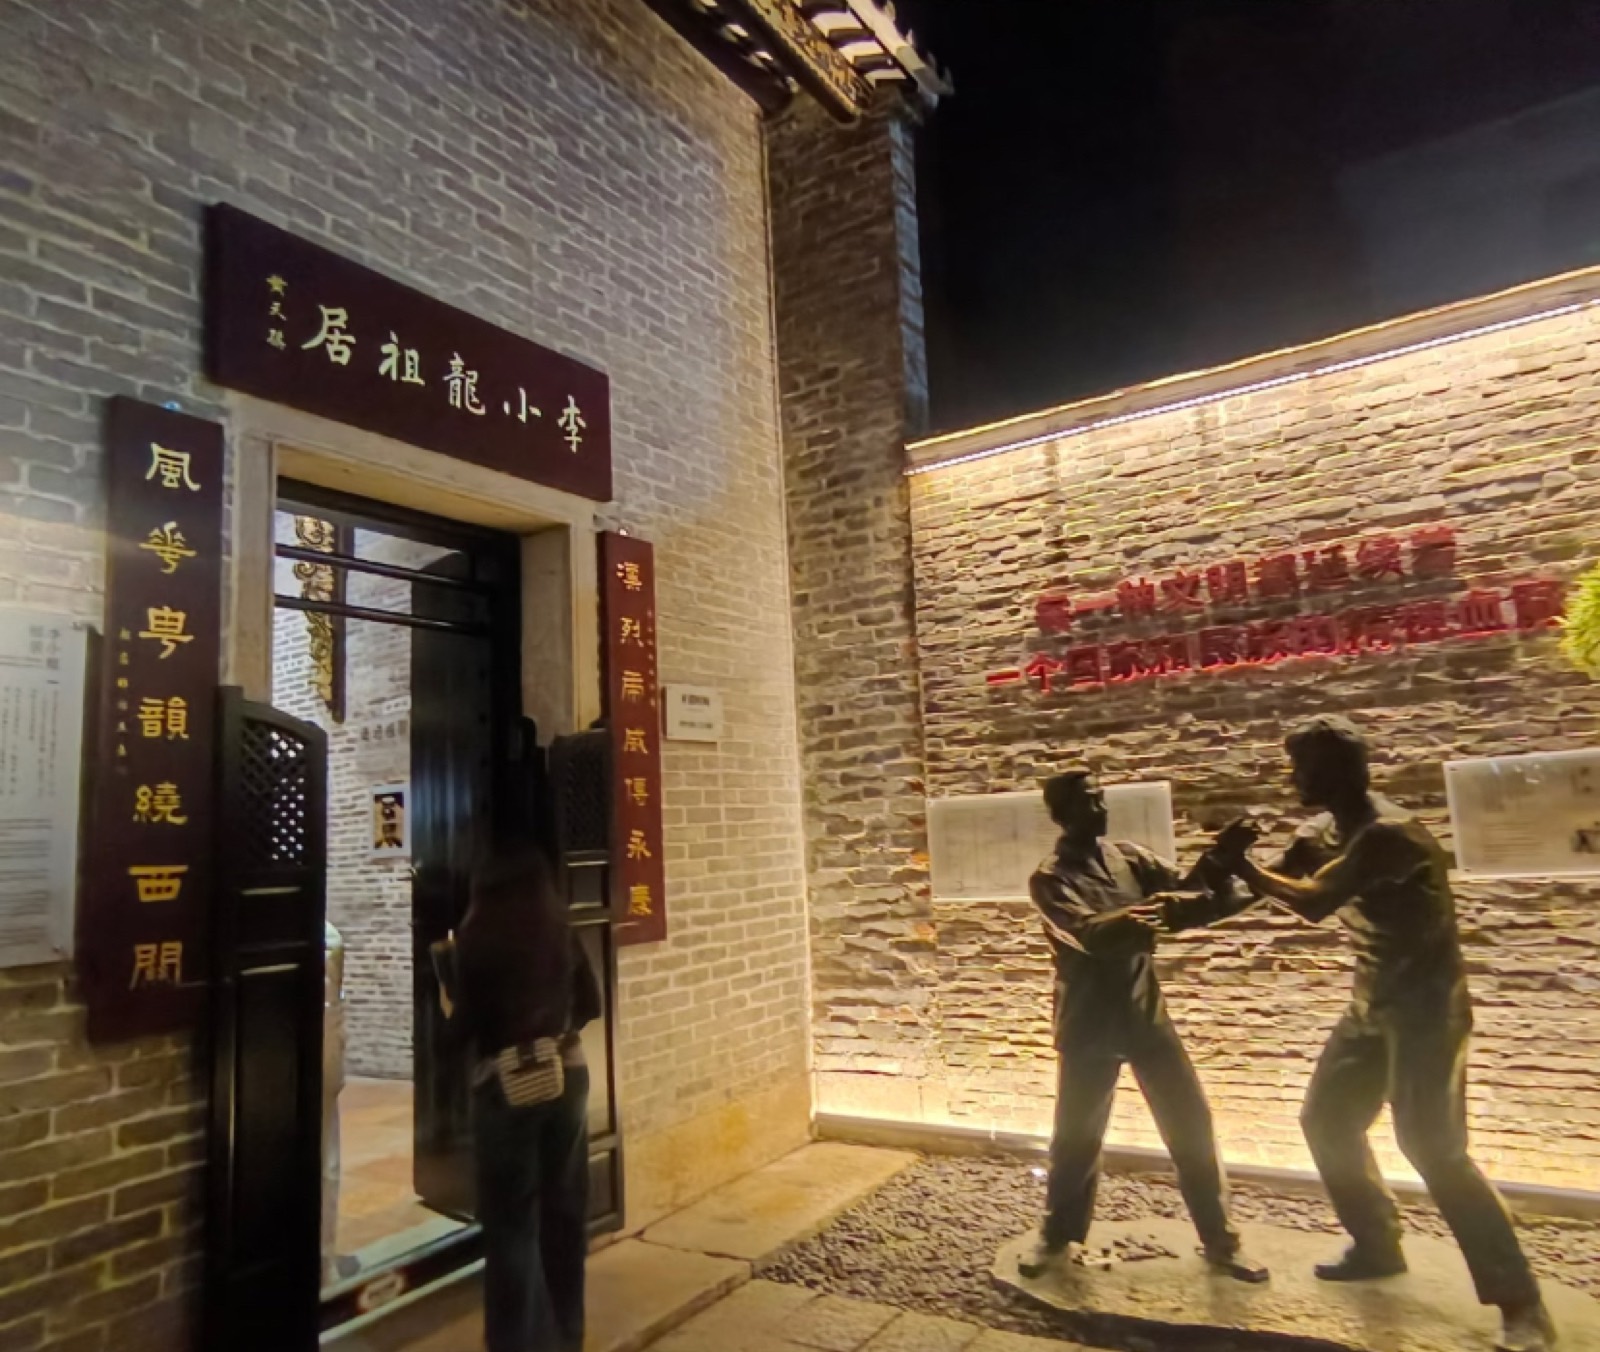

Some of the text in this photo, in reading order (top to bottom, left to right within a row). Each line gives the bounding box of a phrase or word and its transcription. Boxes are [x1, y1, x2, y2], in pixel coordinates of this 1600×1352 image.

[301, 304, 588, 453] 李小龍祖居
